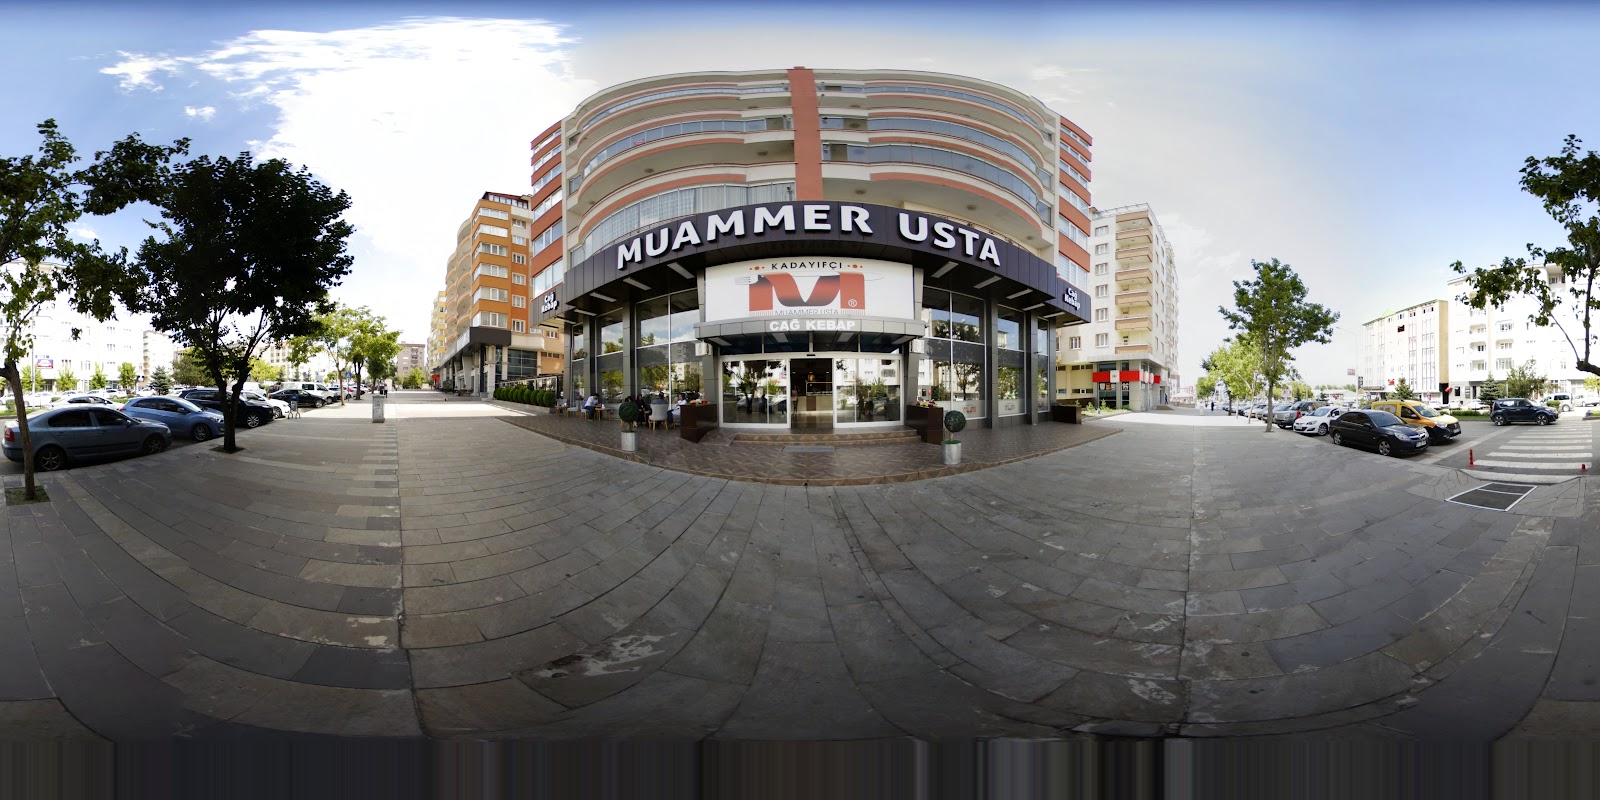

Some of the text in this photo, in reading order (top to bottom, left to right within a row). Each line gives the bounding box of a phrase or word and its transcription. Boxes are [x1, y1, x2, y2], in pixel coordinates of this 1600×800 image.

[616, 204, 1001, 270] MUAMMER USTA
[771, 261, 842, 270] KADAYIFÇI
[769, 318, 856, 331] CAĞ KEBAP
